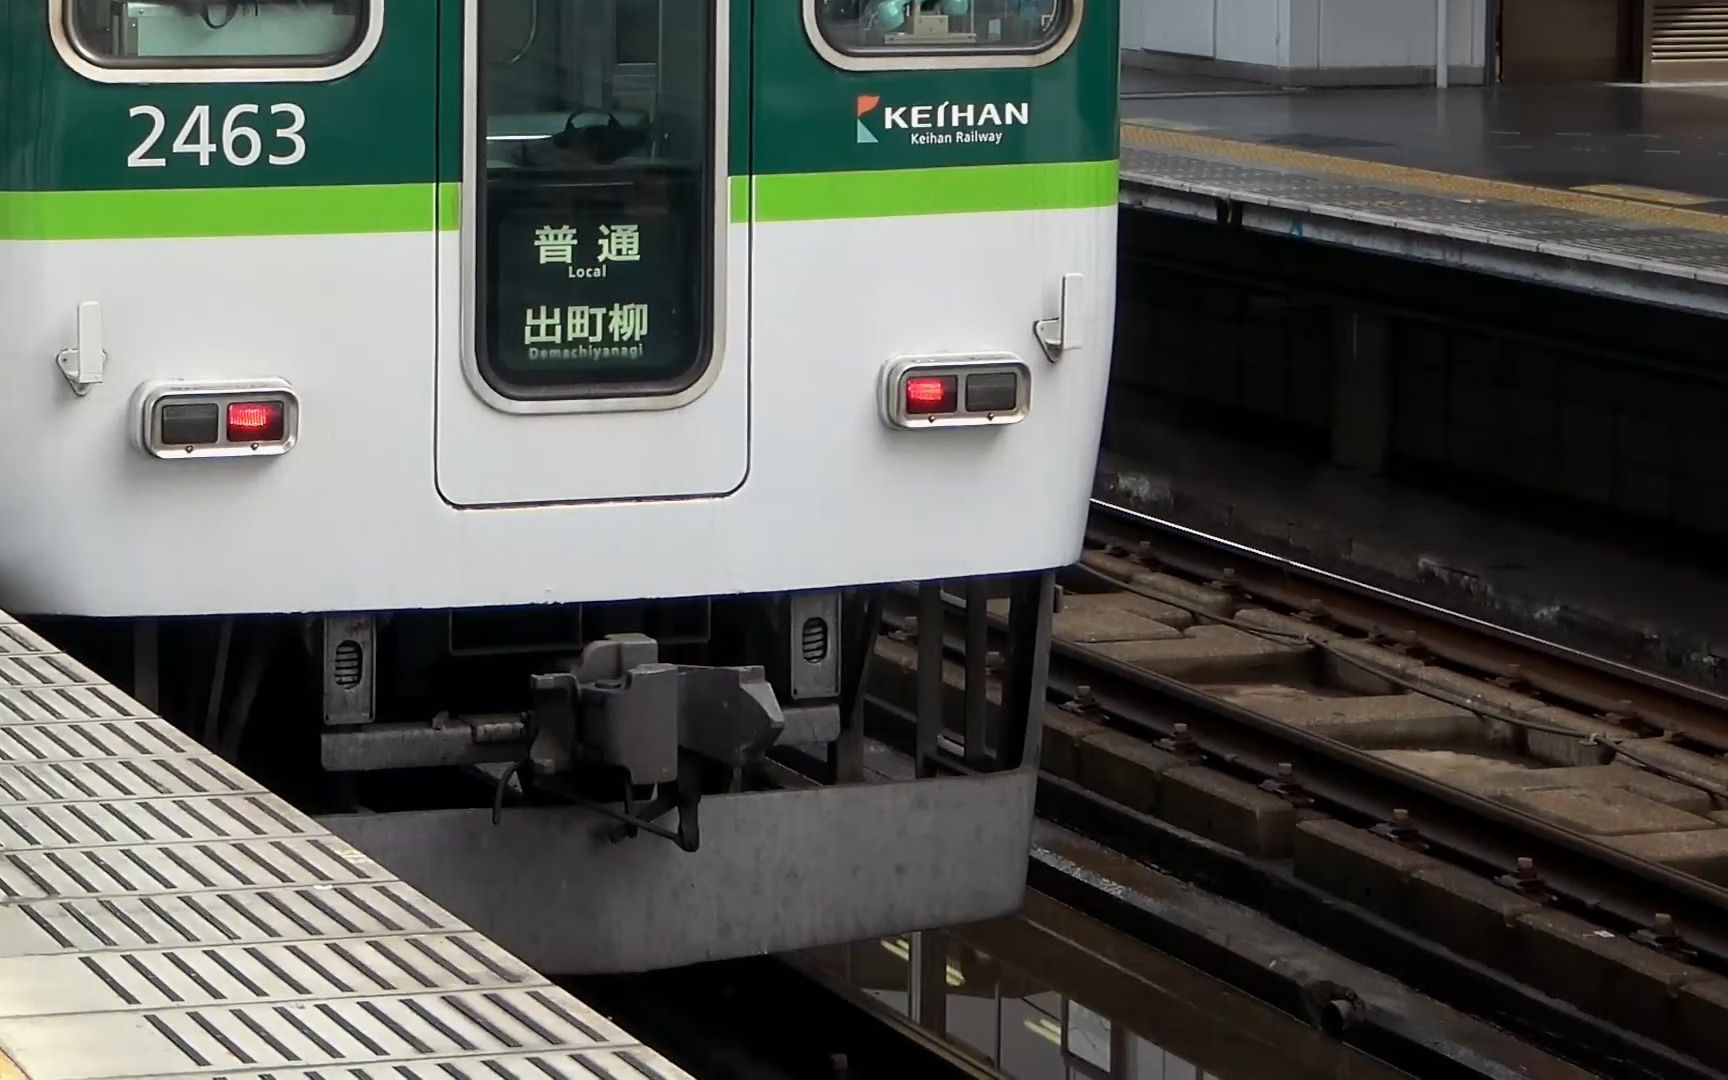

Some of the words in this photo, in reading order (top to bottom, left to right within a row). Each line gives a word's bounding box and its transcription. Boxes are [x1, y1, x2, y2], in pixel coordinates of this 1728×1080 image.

[884, 101, 1028, 130] KEIHAN
[127, 102, 307, 168] 2463
[910, 132, 952, 145] Keihan
[955, 131, 1003, 145] Railway
[533, 224, 641, 265] 普通
[568, 264, 607, 279] Local
[524, 303, 649, 345] 出町柳
[528, 343, 644, 361] Demachiyanagi
